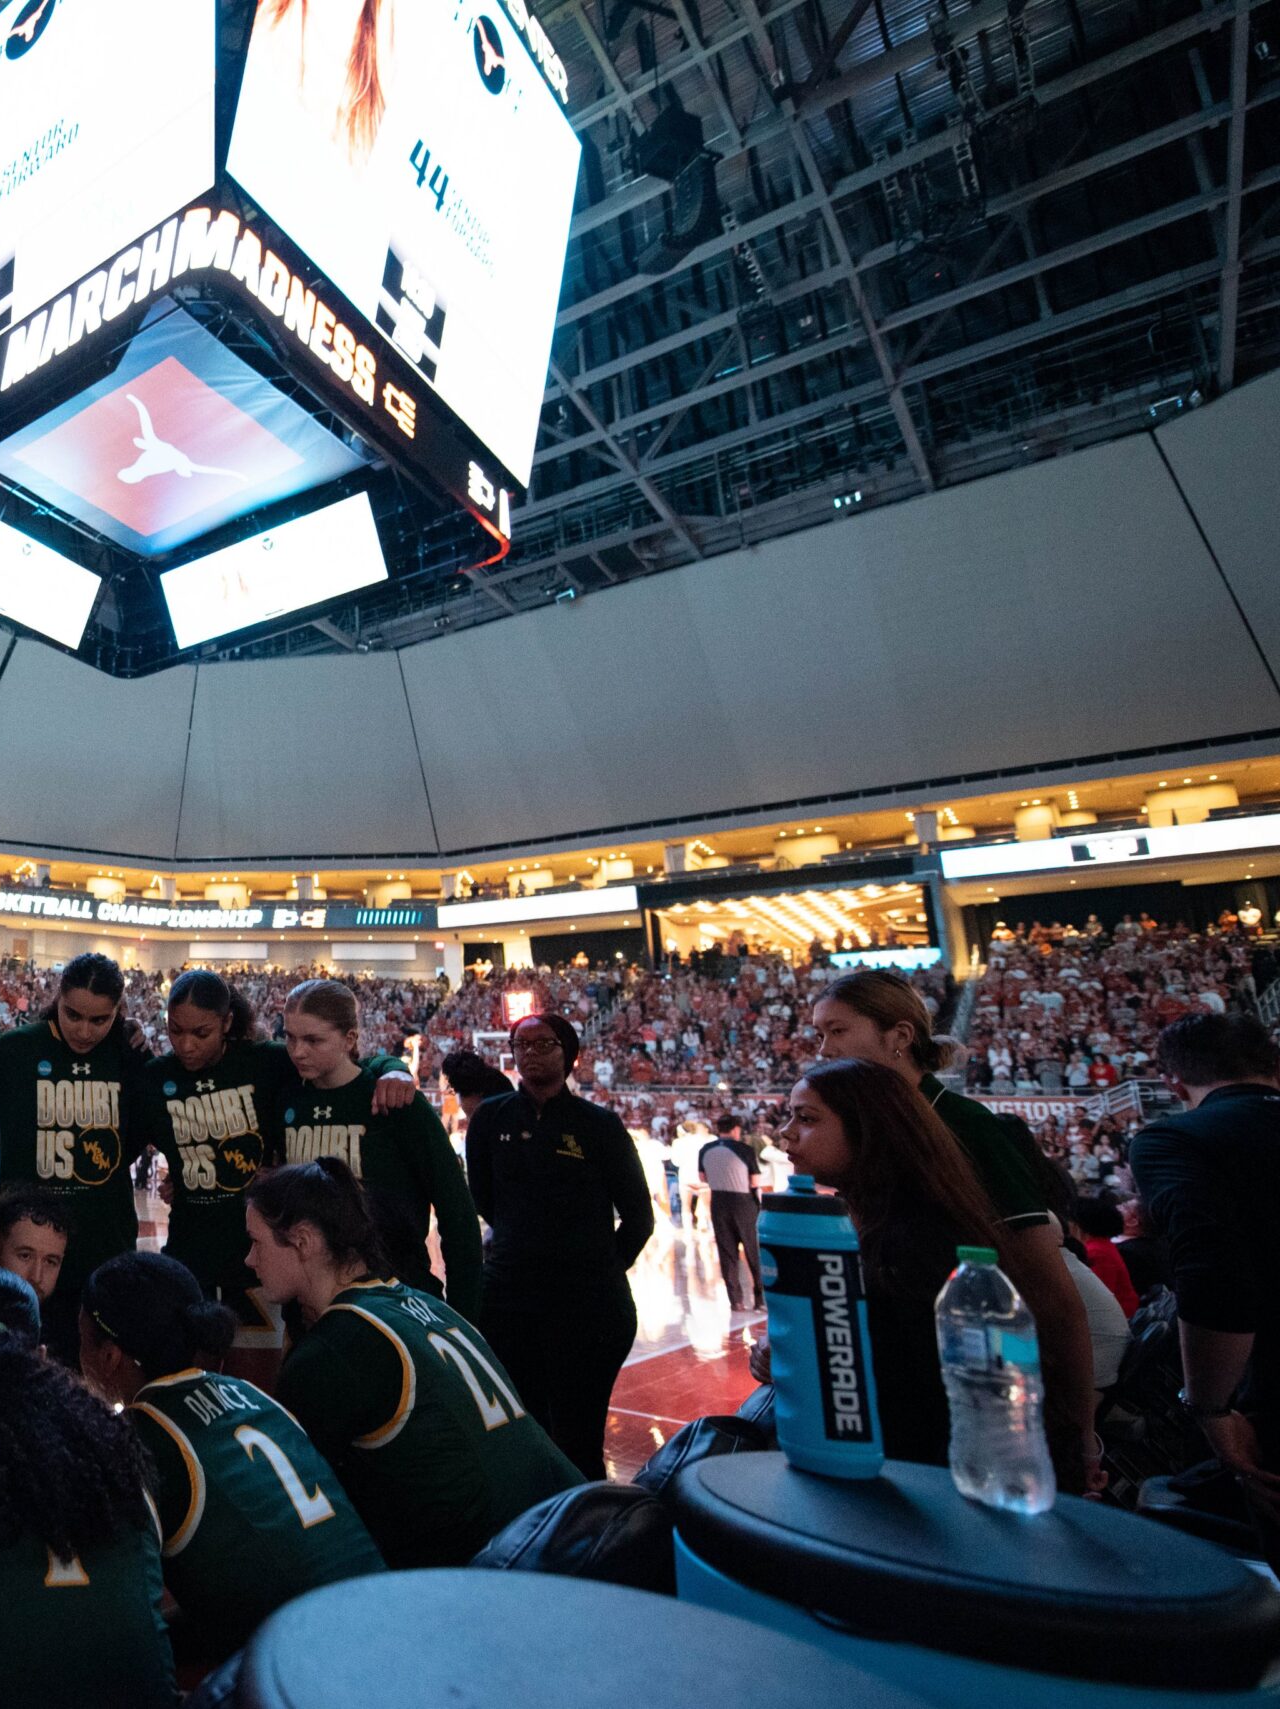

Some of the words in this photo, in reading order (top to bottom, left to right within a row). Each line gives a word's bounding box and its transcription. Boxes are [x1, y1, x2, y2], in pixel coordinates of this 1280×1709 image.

[409, 138, 449, 213] 44
[0, 216, 179, 392] MARCH
[172, 206, 377, 407] MADNESS
[96, 901, 264, 928] CHAMPIONSHIP
[37, 1079, 122, 1129] DOUBT
[166, 1084, 259, 1145] DOUBT
[36, 1129, 75, 1180] US
[178, 1143, 217, 1191] US
[817, 1253, 863, 1434] POWERADE
[184, 1381, 262, 1427] DANCE
[427, 1326, 527, 1432] 21
[233, 1424, 337, 1530] 2
